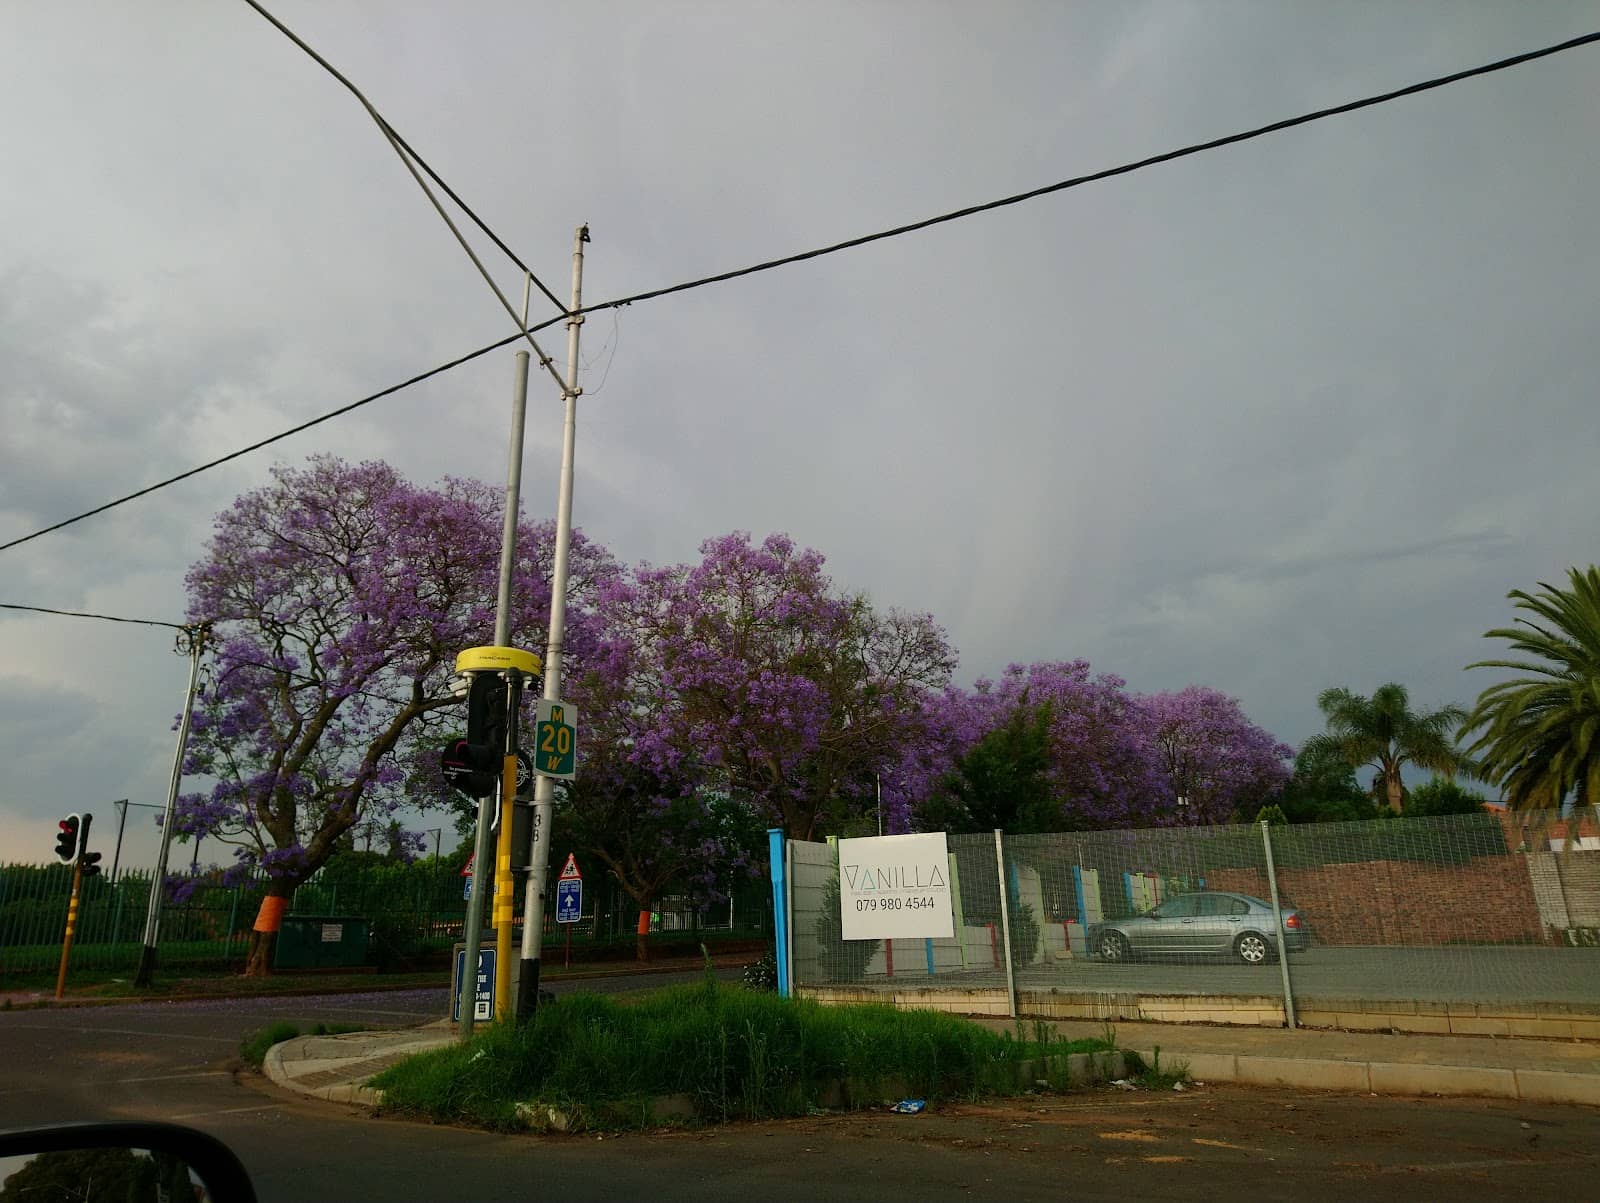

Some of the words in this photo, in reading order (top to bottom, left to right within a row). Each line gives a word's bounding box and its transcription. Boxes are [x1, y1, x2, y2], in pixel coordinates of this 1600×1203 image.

[552, 707, 563, 723] M
[541, 724, 570, 754] 20
[547, 755, 563, 771] W
[843, 864, 946, 890] VANILLA
[856, 898, 877, 912] 079
[880, 897, 902, 911] 980
[905, 896, 935, 910] 4544
